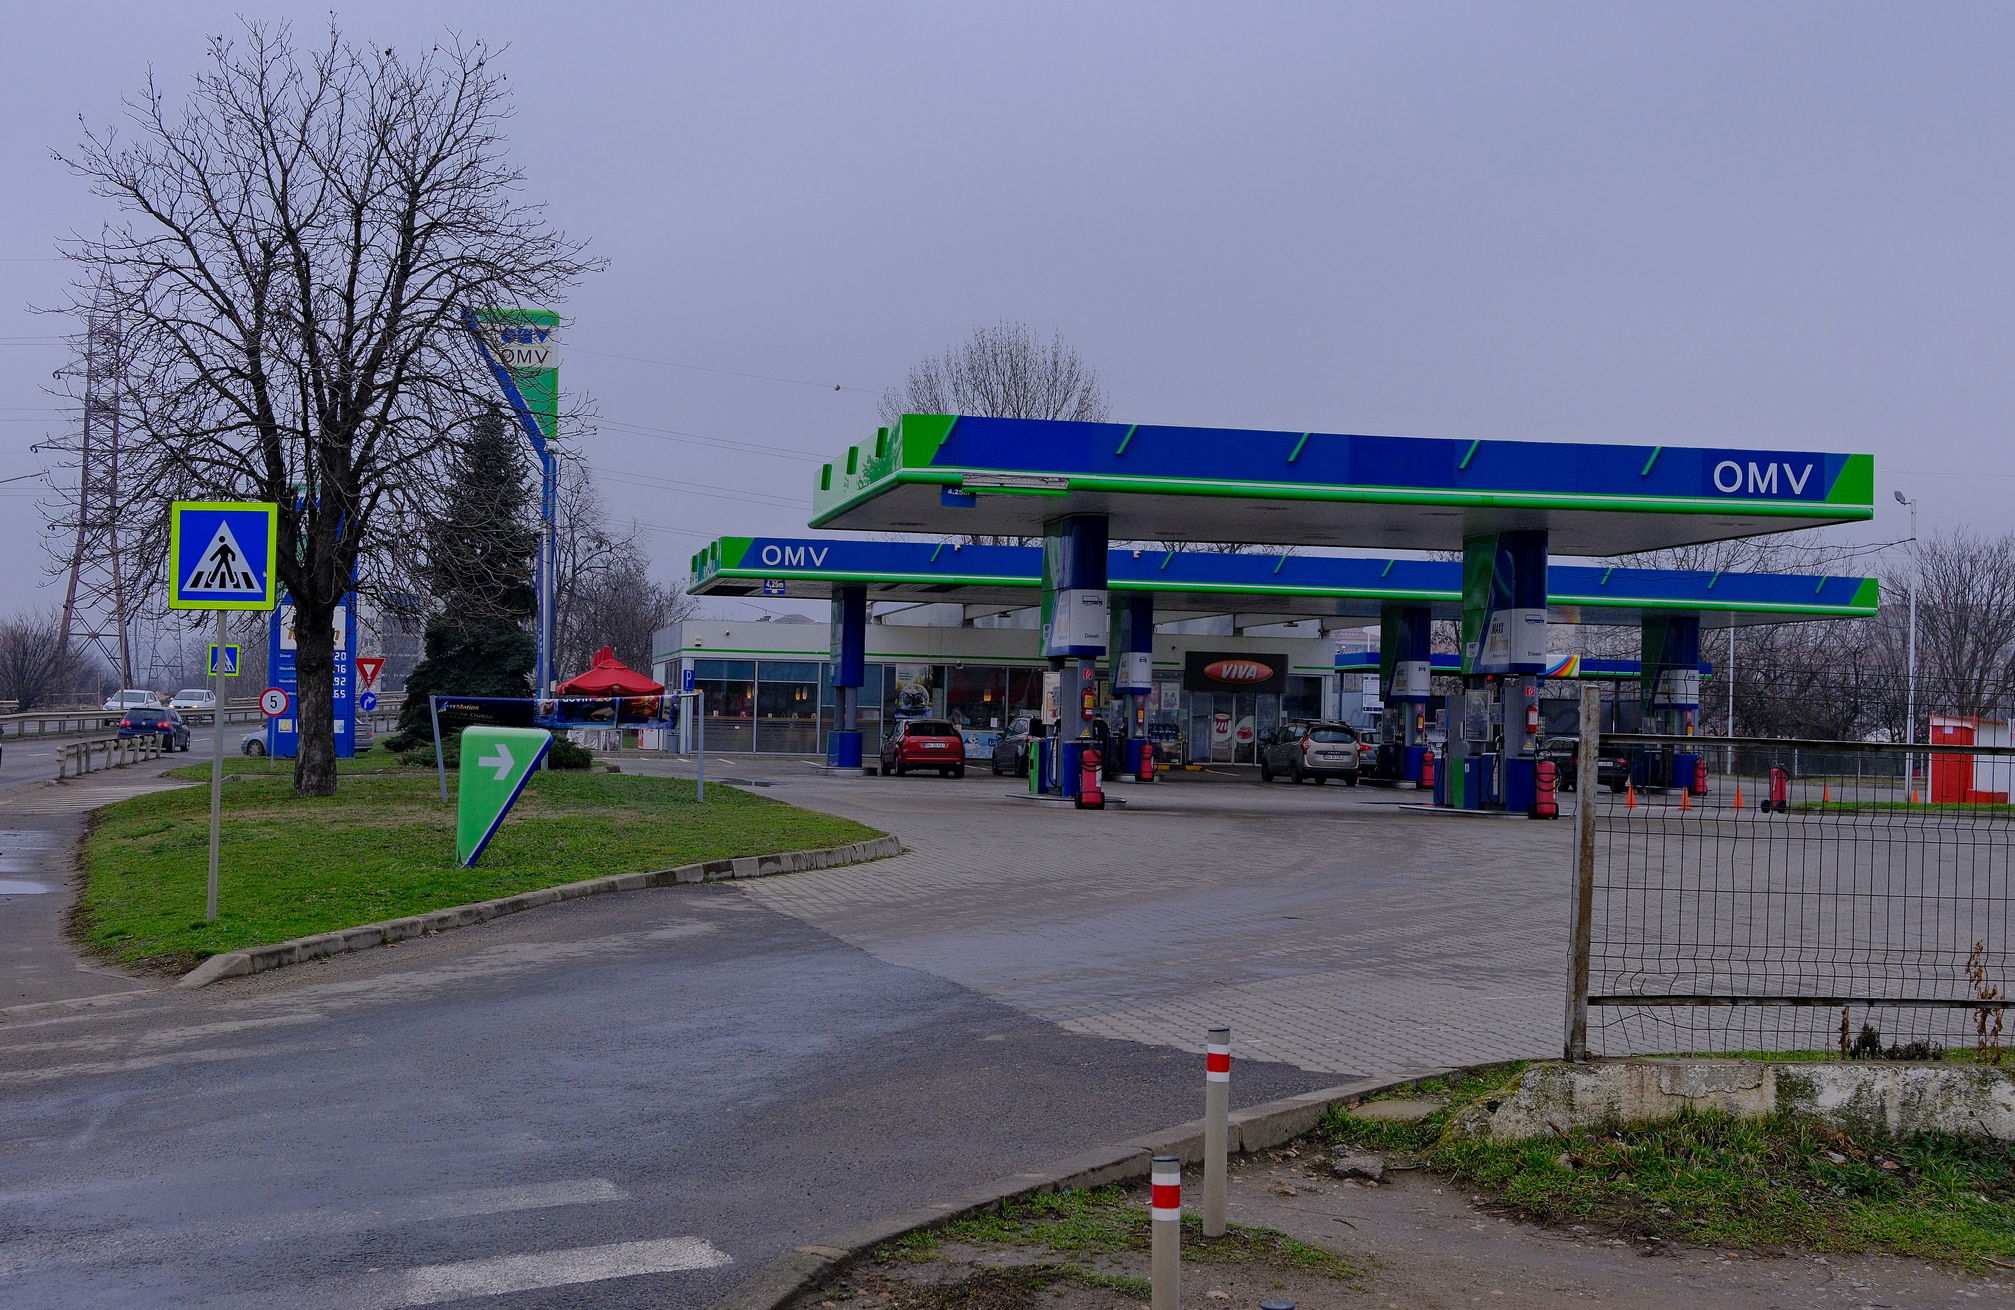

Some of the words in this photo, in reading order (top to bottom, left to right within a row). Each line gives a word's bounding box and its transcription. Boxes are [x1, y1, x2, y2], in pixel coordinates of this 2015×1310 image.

[502, 349, 549, 364] OMV
[1713, 460, 1813, 495] OMV
[762, 545, 829, 567] OMV
[1221, 664, 1258, 680] VIVA
[270, 695, 278, 709] 5
